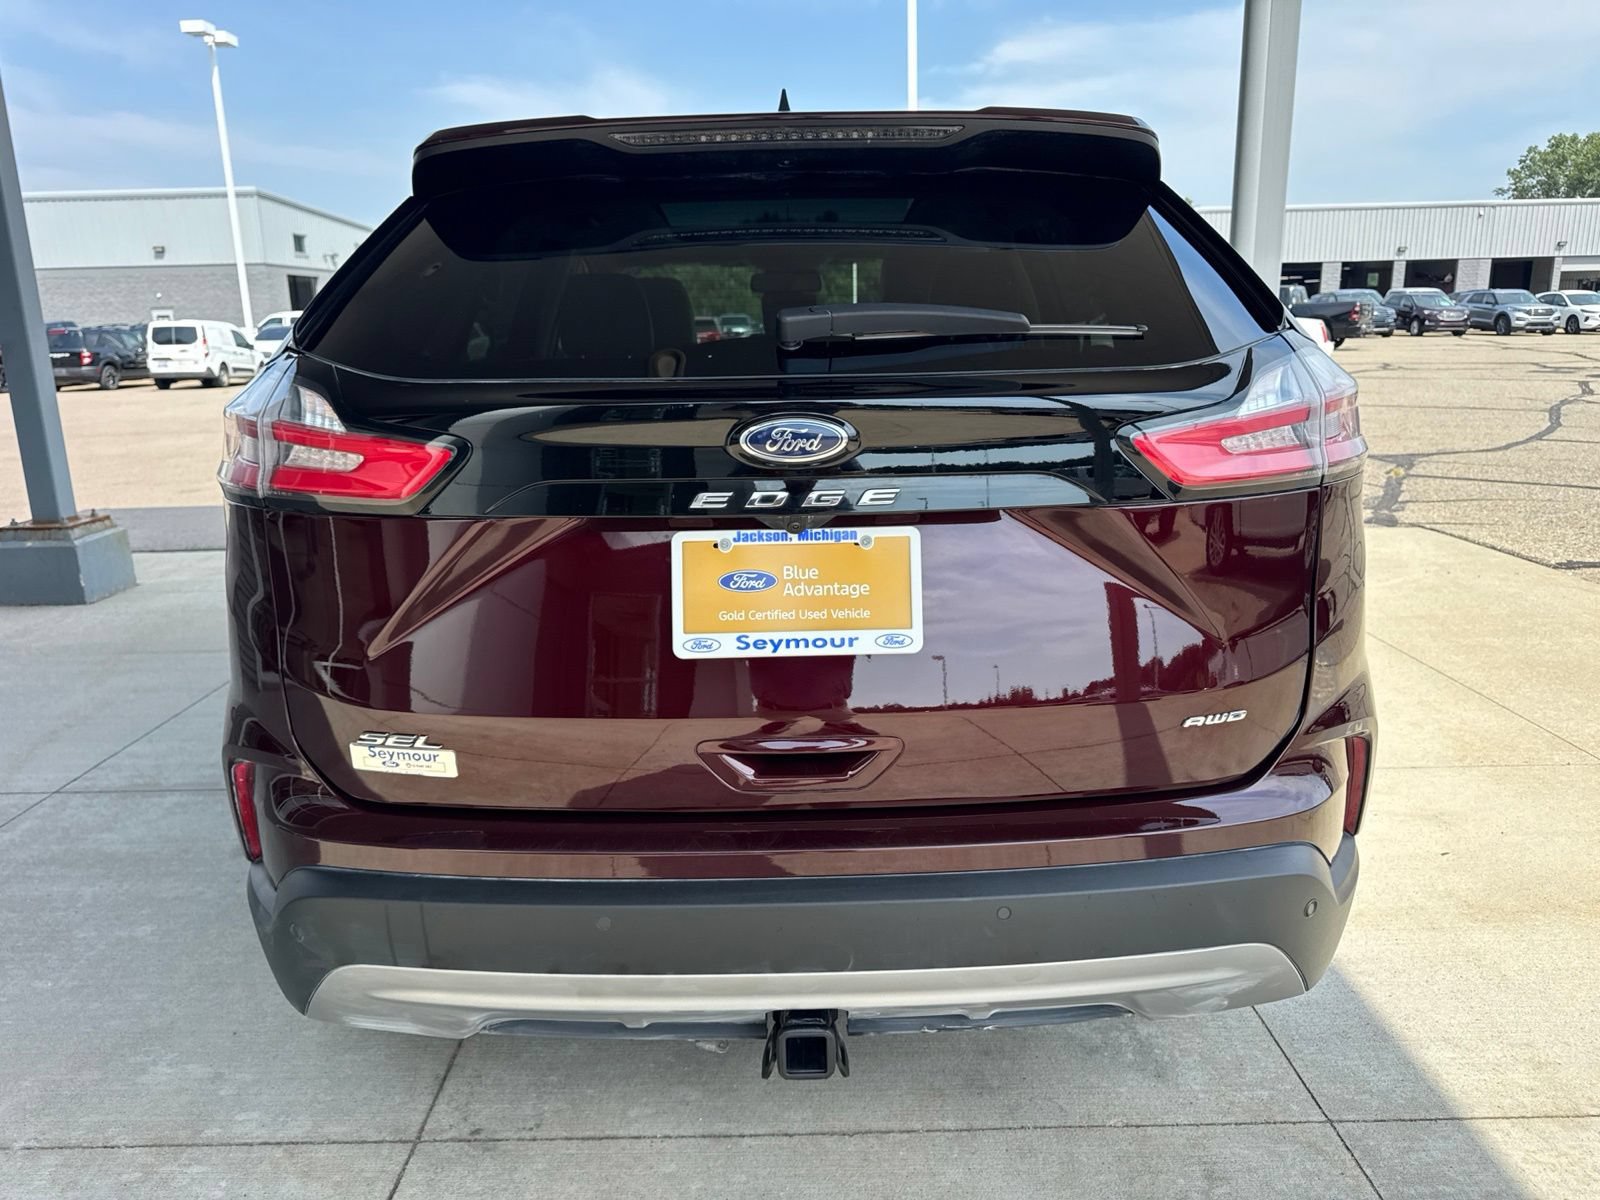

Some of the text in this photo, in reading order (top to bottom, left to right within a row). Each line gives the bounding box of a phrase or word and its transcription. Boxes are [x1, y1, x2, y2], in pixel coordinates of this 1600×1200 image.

[765, 427, 823, 452] Ford
[689, 488, 901, 509] EDGE
[733, 529, 858, 543] Jackson, Michigan
[729, 573, 767, 589] Ford
[783, 565, 819, 580] Blue
[783, 582, 870, 599] Advantage
[718, 608, 871, 622] Gold Certified Used Vehicle
[690, 640, 714, 650] Ford
[735, 634, 860, 654] Seymour
[882, 634, 906, 646] Ford
[1182, 709, 1248, 728] AWD
[357, 731, 443, 750] SEL
[367, 744, 440, 763] Seymour
